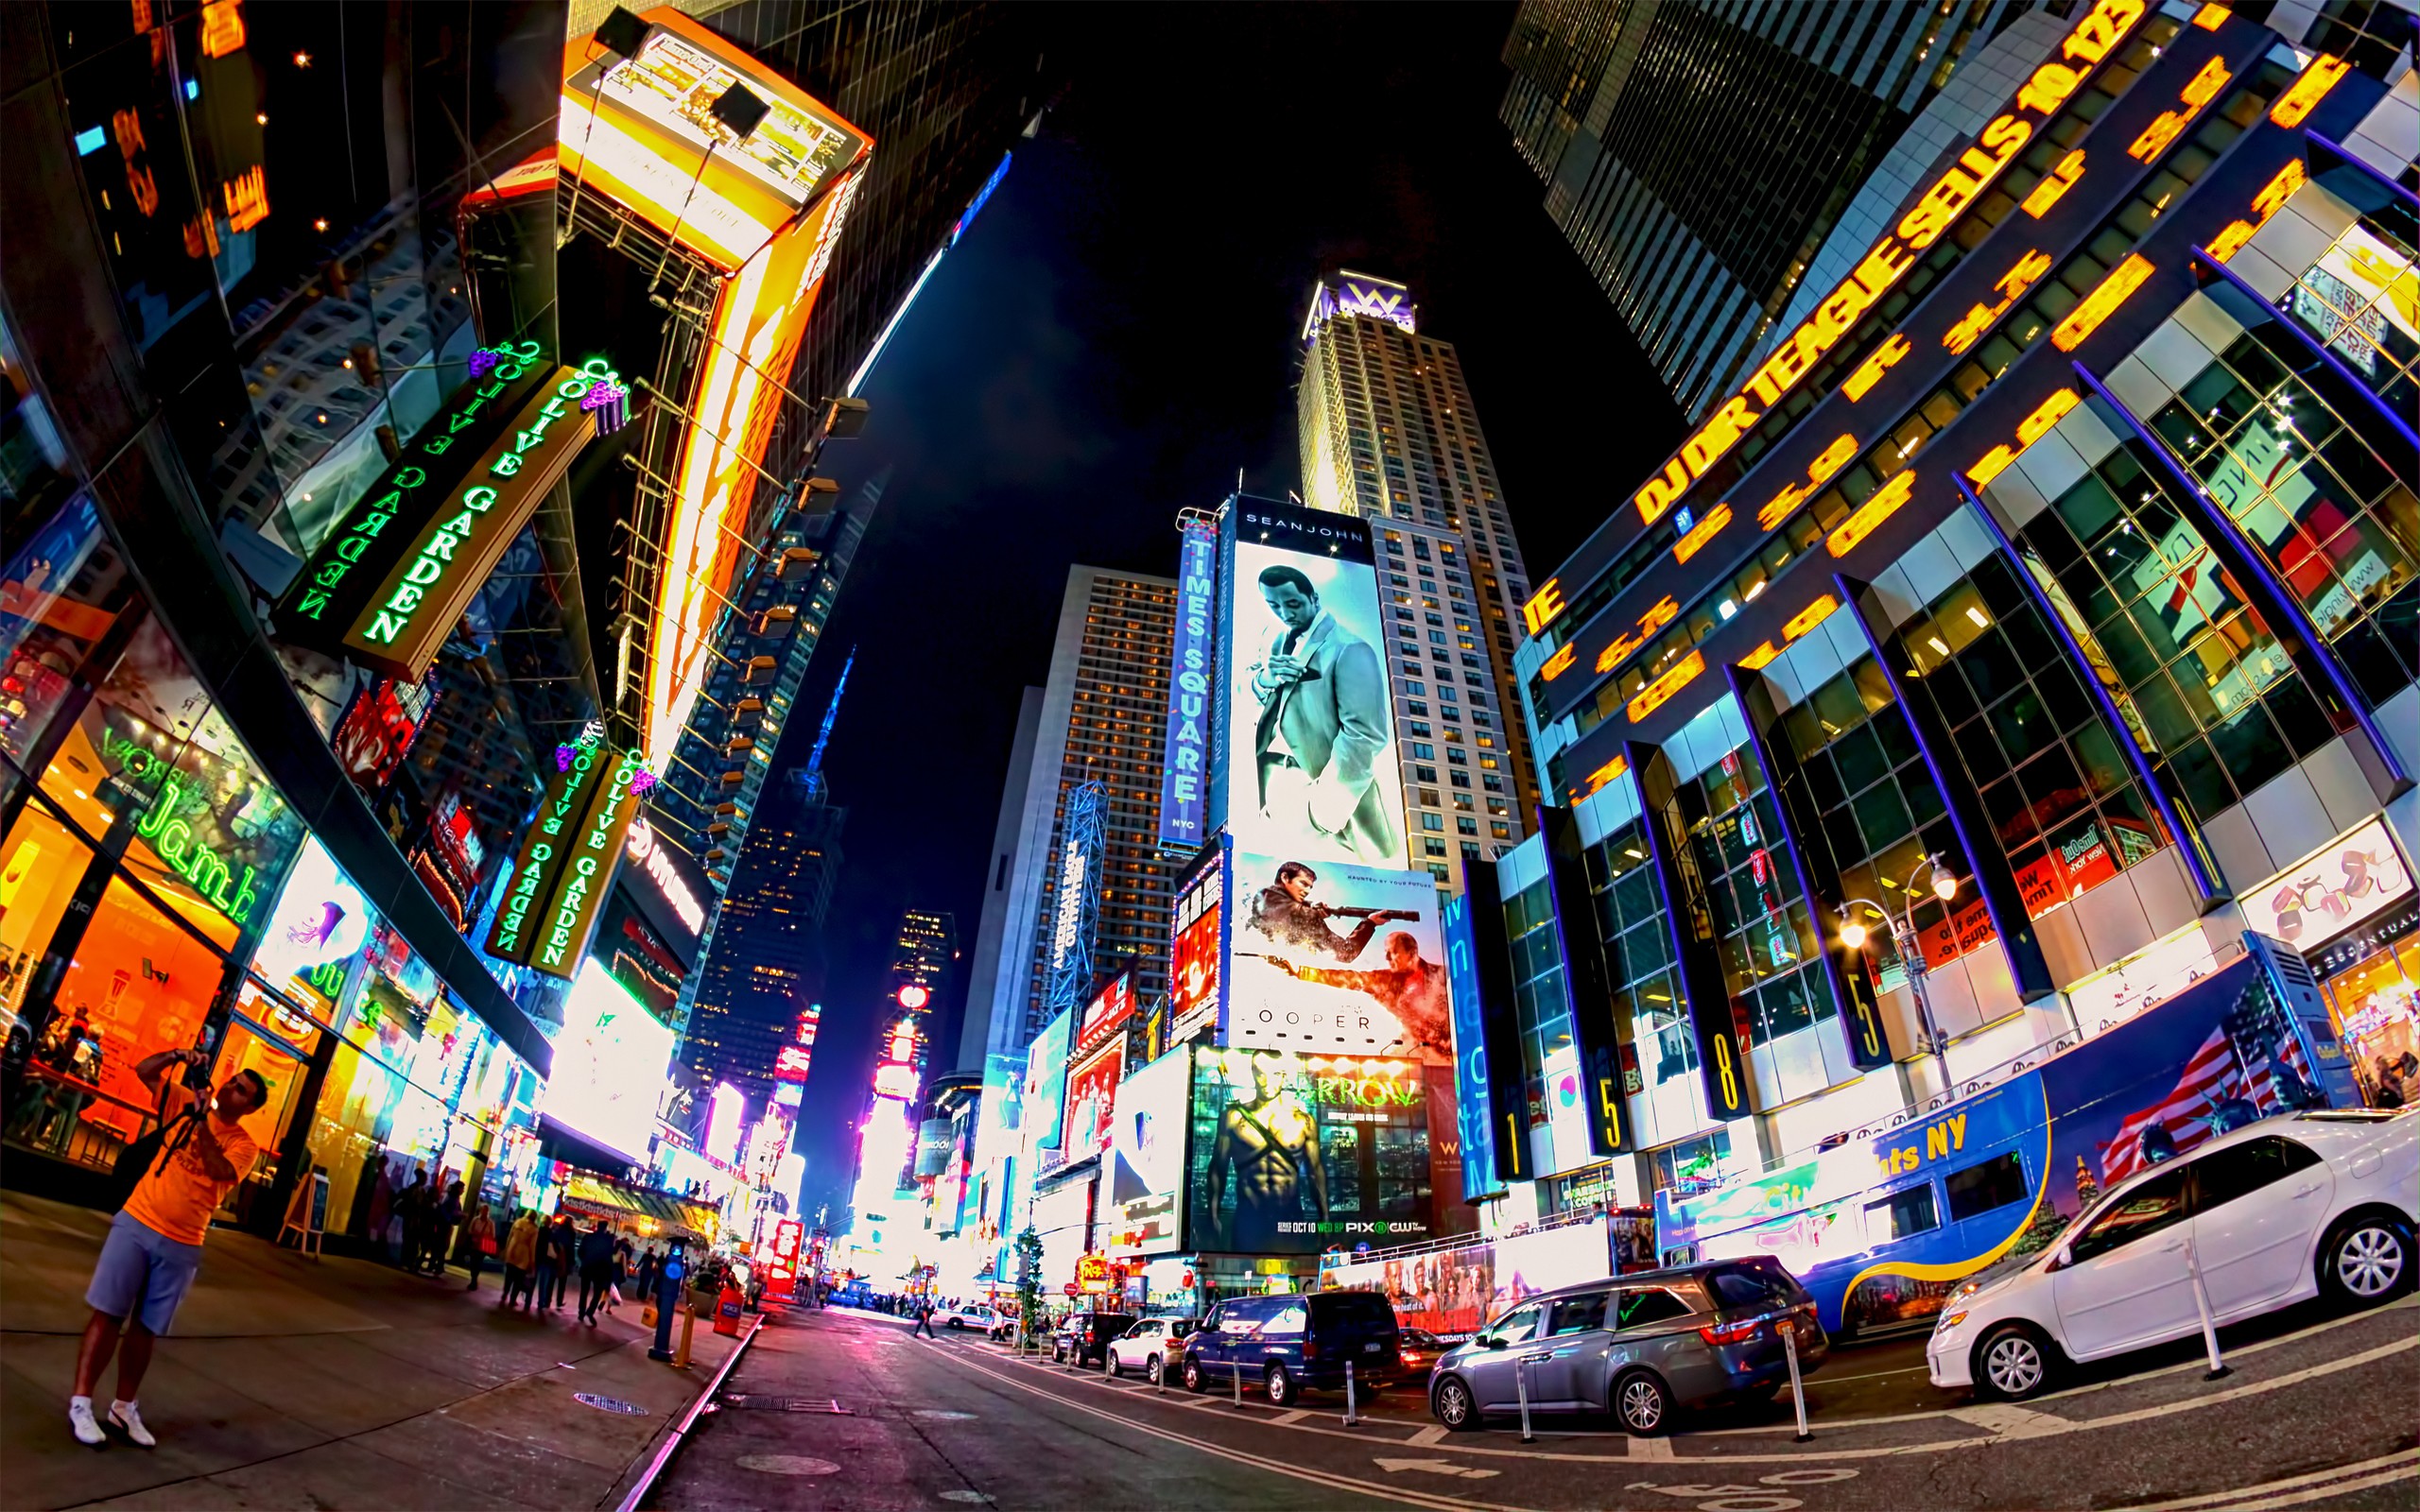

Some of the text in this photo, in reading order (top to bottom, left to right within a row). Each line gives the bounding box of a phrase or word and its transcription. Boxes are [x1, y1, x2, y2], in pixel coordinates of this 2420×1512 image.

[1742, 236, 1916, 408] TEAGUE
[1897, 114, 2032, 249] SELLS
[1347, 283, 1403, 317] W
[363, 379, 588, 644] OLIVE GARDEN
[1174, 539, 1213, 801] TIMES SQUARE
[1171, 818, 1196, 831] NYC
[541, 767, 635, 967] OLIVE GARDEN
[1347, 875, 1377, 884] HAUNTED
[1241, 1008, 1370, 1030] OOPER
[1848, 973, 1880, 1057] 5
[1294, 1073, 1420, 1108] ARROW
[1714, 1033, 1738, 1110] 8
[1599, 1078, 1621, 1148] 5
[1927, 1113, 1967, 1160] NY
[1440, 1142, 1459, 1156] W
[1507, 1112, 1520, 1175] 1
[1292, 1222, 1306, 1233] OCT
[1308, 1222, 1317, 1233] 10
[1318, 1222, 1333, 1233] WED
